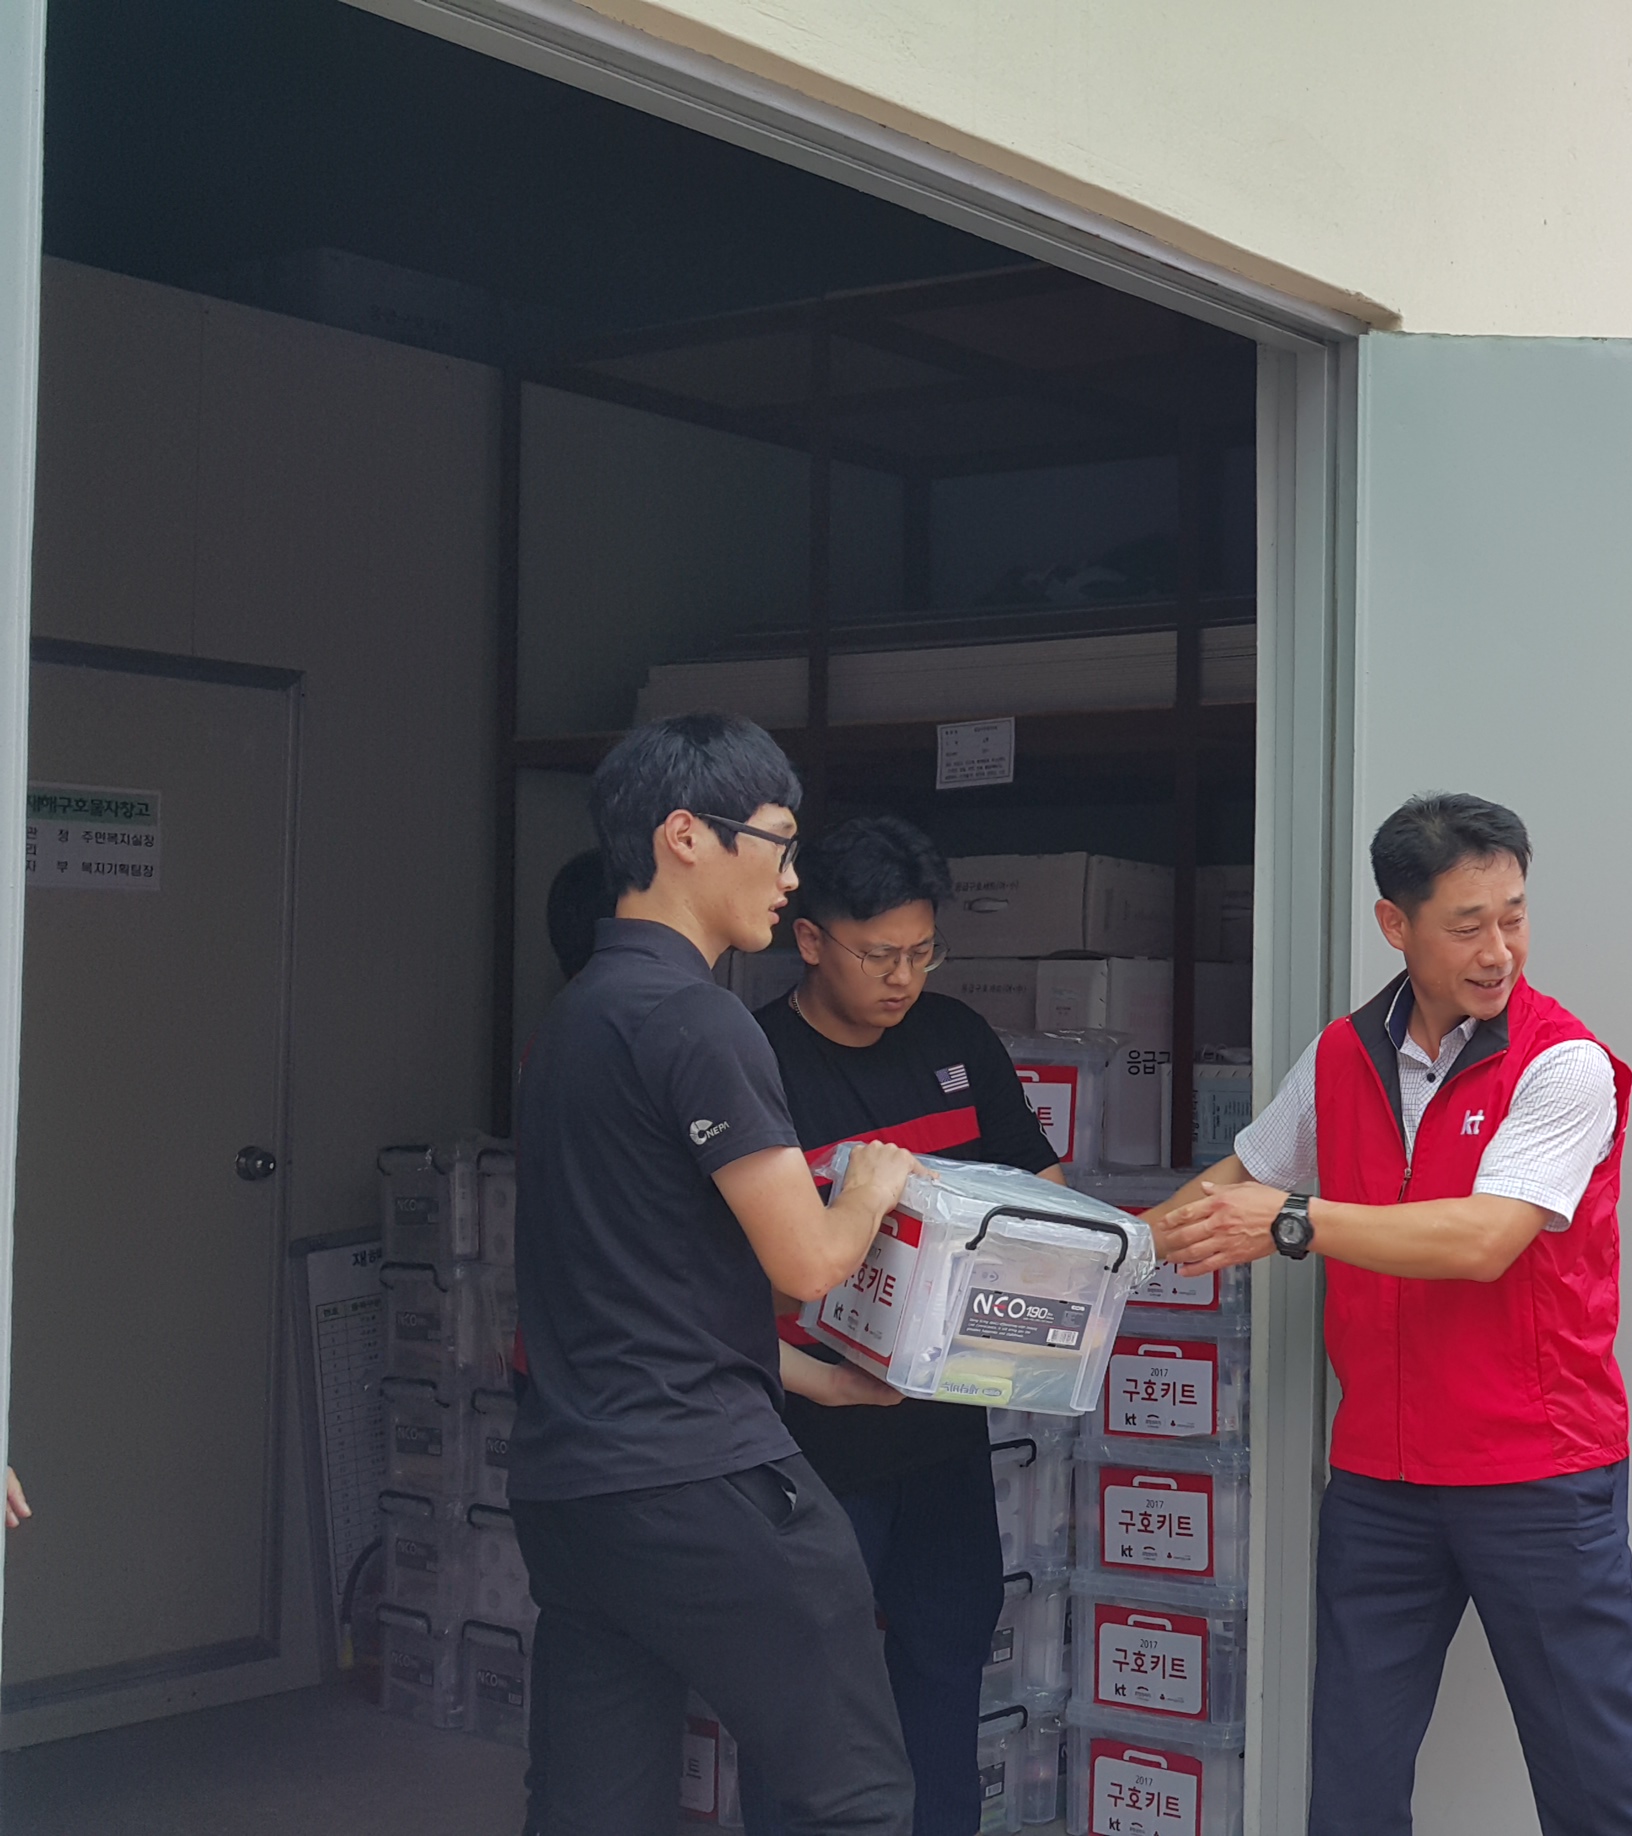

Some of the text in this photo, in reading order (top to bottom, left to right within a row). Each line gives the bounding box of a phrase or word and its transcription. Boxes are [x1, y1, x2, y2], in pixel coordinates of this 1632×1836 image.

[1460, 1109, 1485, 1135] kt
[706, 1121, 730, 1139] NEPA
[1026, 1306, 1048, 1319] 190
[1151, 1368, 1169, 1378] 2017
[1123, 1379, 1197, 1406] 구호키트
[1125, 1413, 1137, 1426] kt
[1146, 1499, 1164, 1509] 2017
[1118, 1510, 1193, 1538] 구호키트
[1121, 1545, 1133, 1557] kt
[1140, 1639, 1158, 1649] 2017
[1112, 1648, 1187, 1680] 구호키트
[1114, 1683, 1127, 1697] kt
[1135, 1775, 1153, 1787] 2017
[1107, 1782, 1181, 1818] 구호키트
[1109, 1817, 1121, 1832] kt
